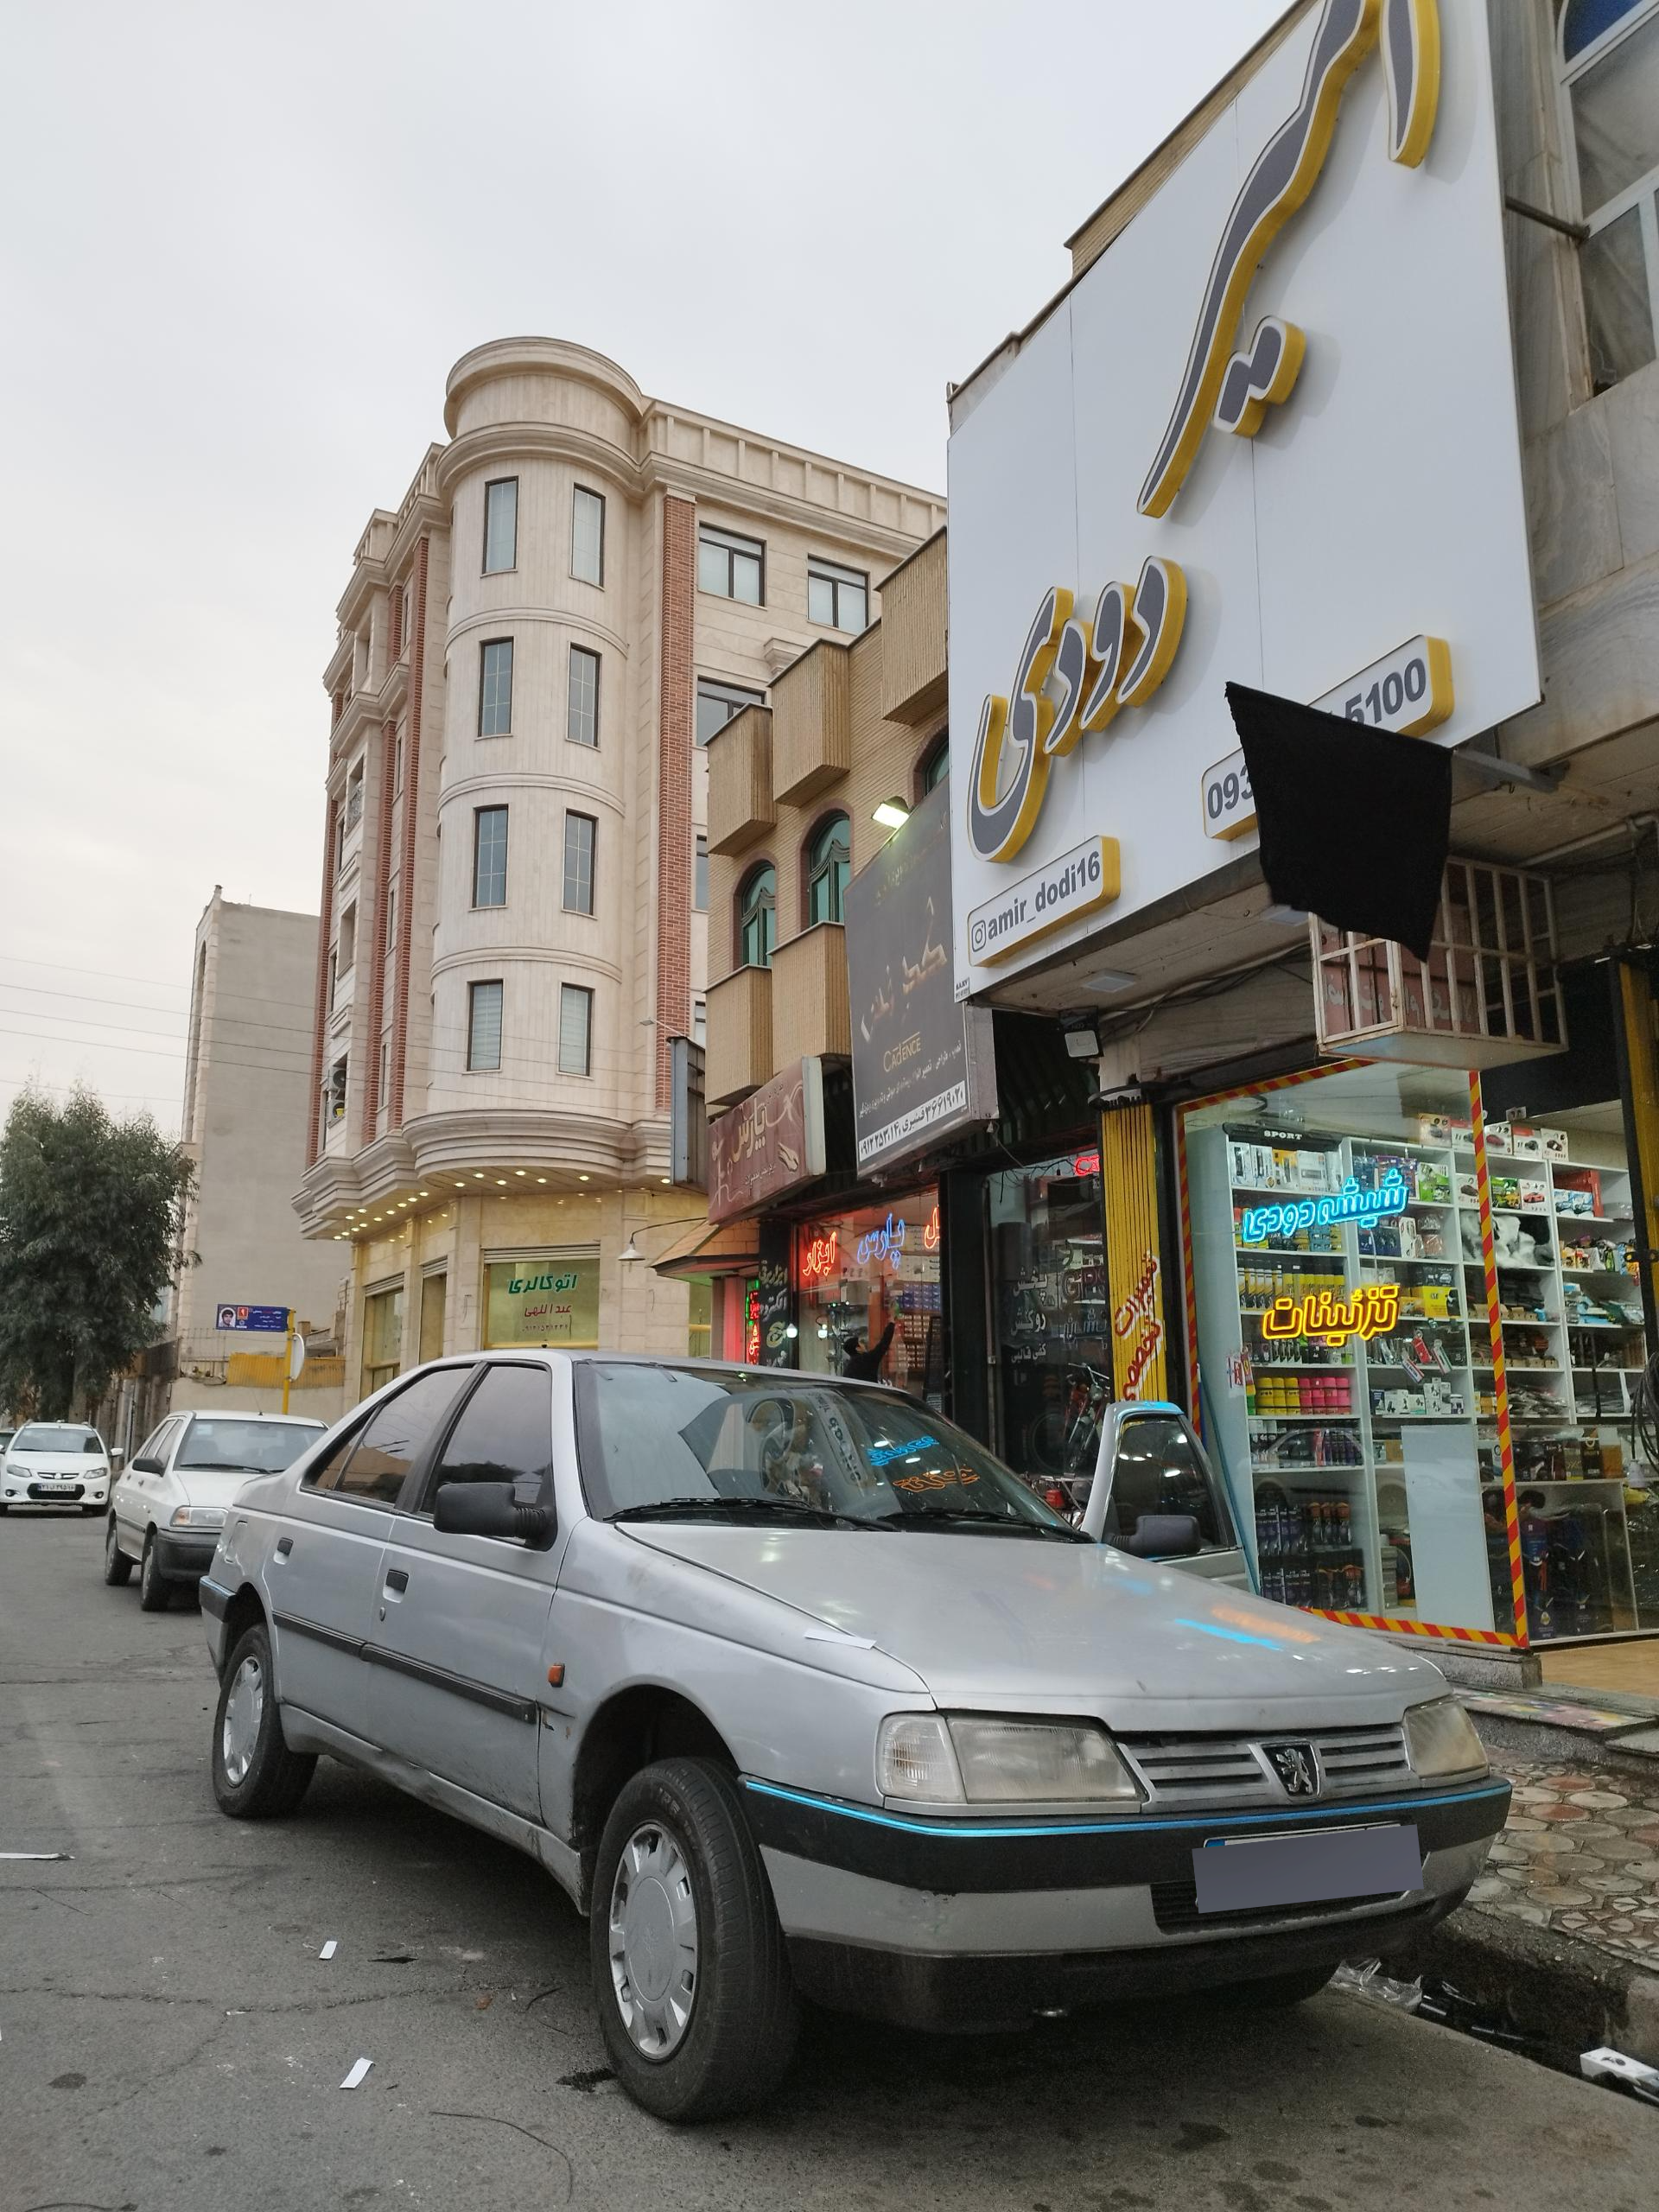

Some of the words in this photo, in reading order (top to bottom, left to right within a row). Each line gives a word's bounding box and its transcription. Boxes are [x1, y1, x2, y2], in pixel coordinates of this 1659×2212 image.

[967, 556, 1188, 863] دودی
[987, 850, 1102, 941] amir_dodi16
[1263, 1129, 1303, 1141] SPORT
[1242, 1200, 1316, 1243] دودی
[1316, 1167, 1409, 1229] شیشه
[802, 1230, 837, 1277] ابزار
[856, 1211, 906, 1271] پارس
